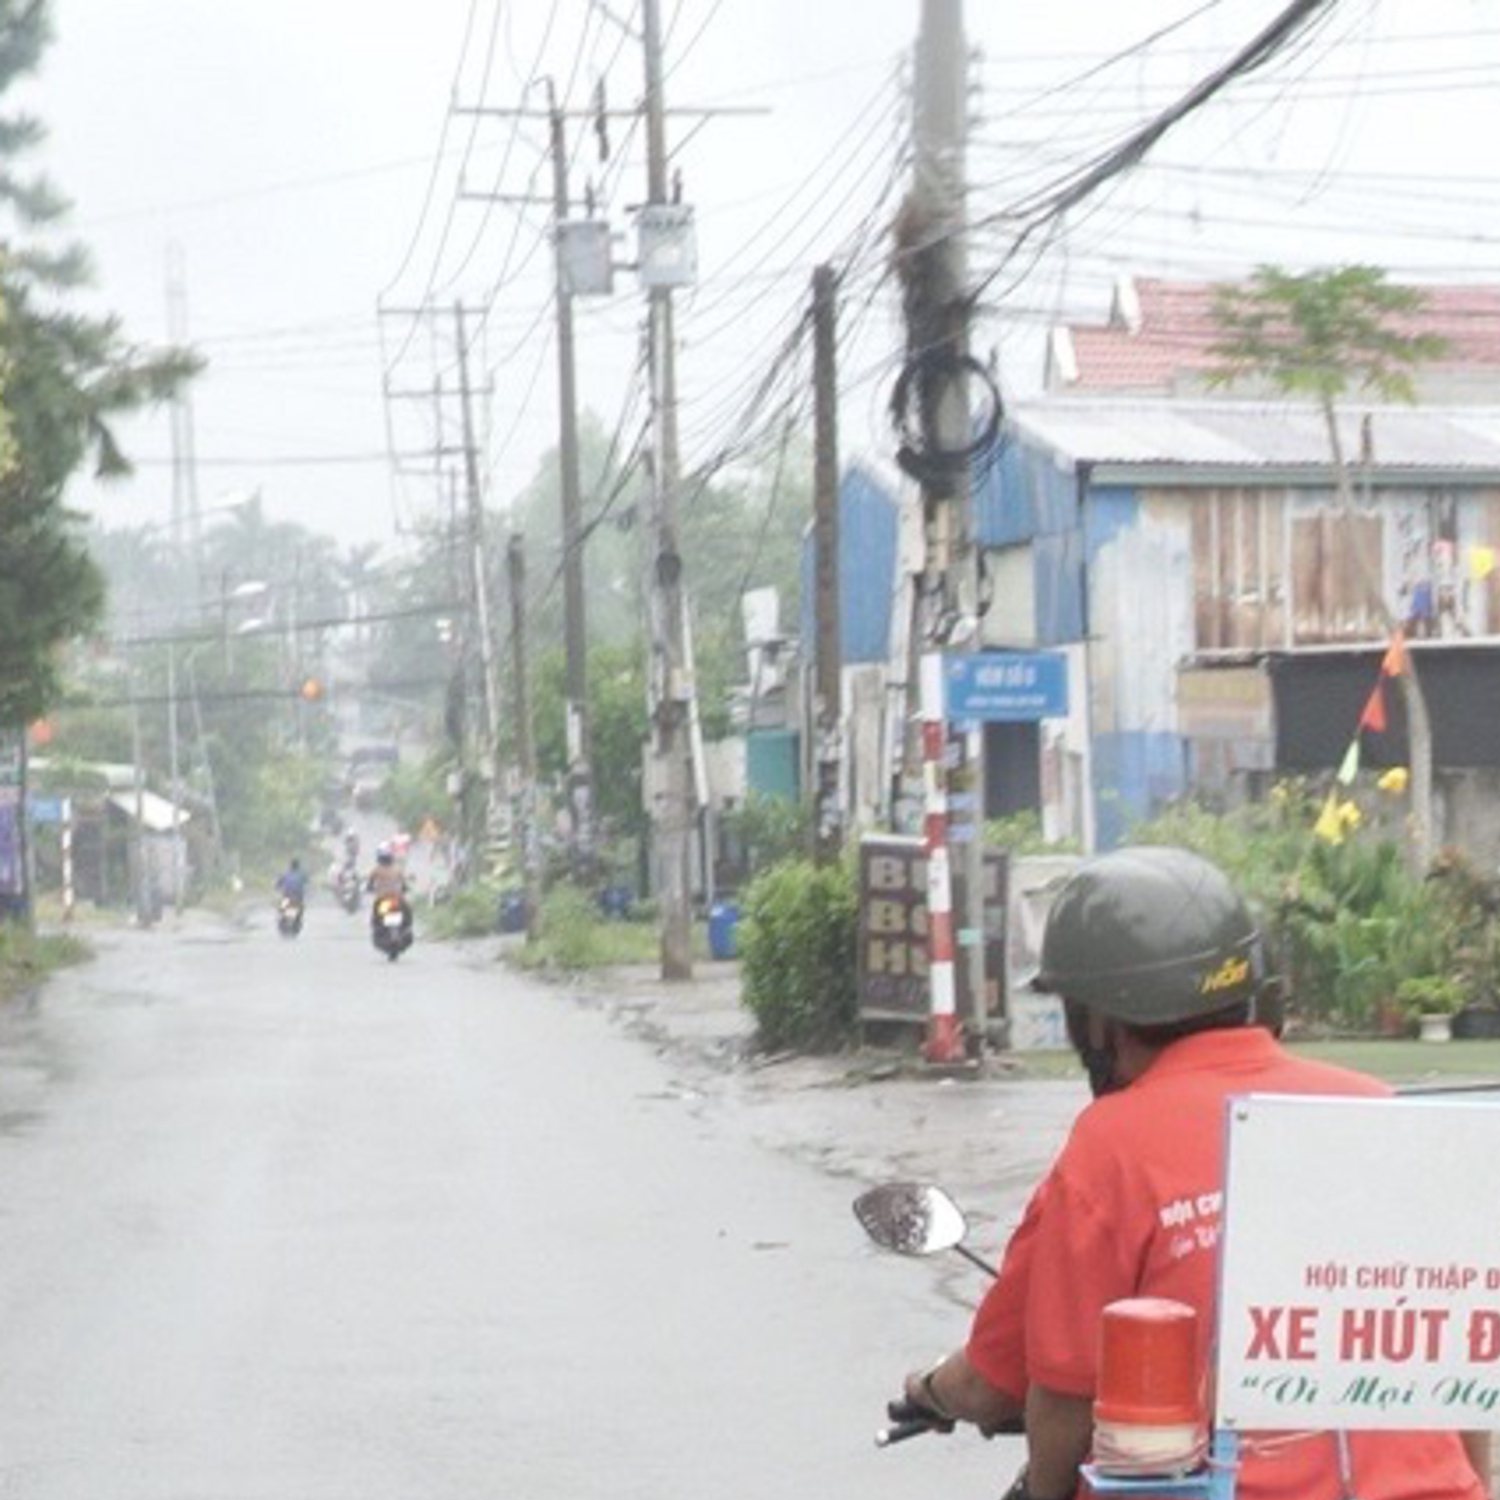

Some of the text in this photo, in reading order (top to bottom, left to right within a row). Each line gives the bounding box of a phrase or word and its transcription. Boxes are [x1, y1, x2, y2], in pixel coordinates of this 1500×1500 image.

[1305, 1262, 1348, 1292] HỘI
[1356, 1260, 1408, 1290] CHỮ
[1413, 1262, 1478, 1294] THẬP
[1245, 1307, 1319, 1361] XE
[1339, 1296, 1450, 1363] HÚT
[1337, 1376, 1415, 1411] Mọi
